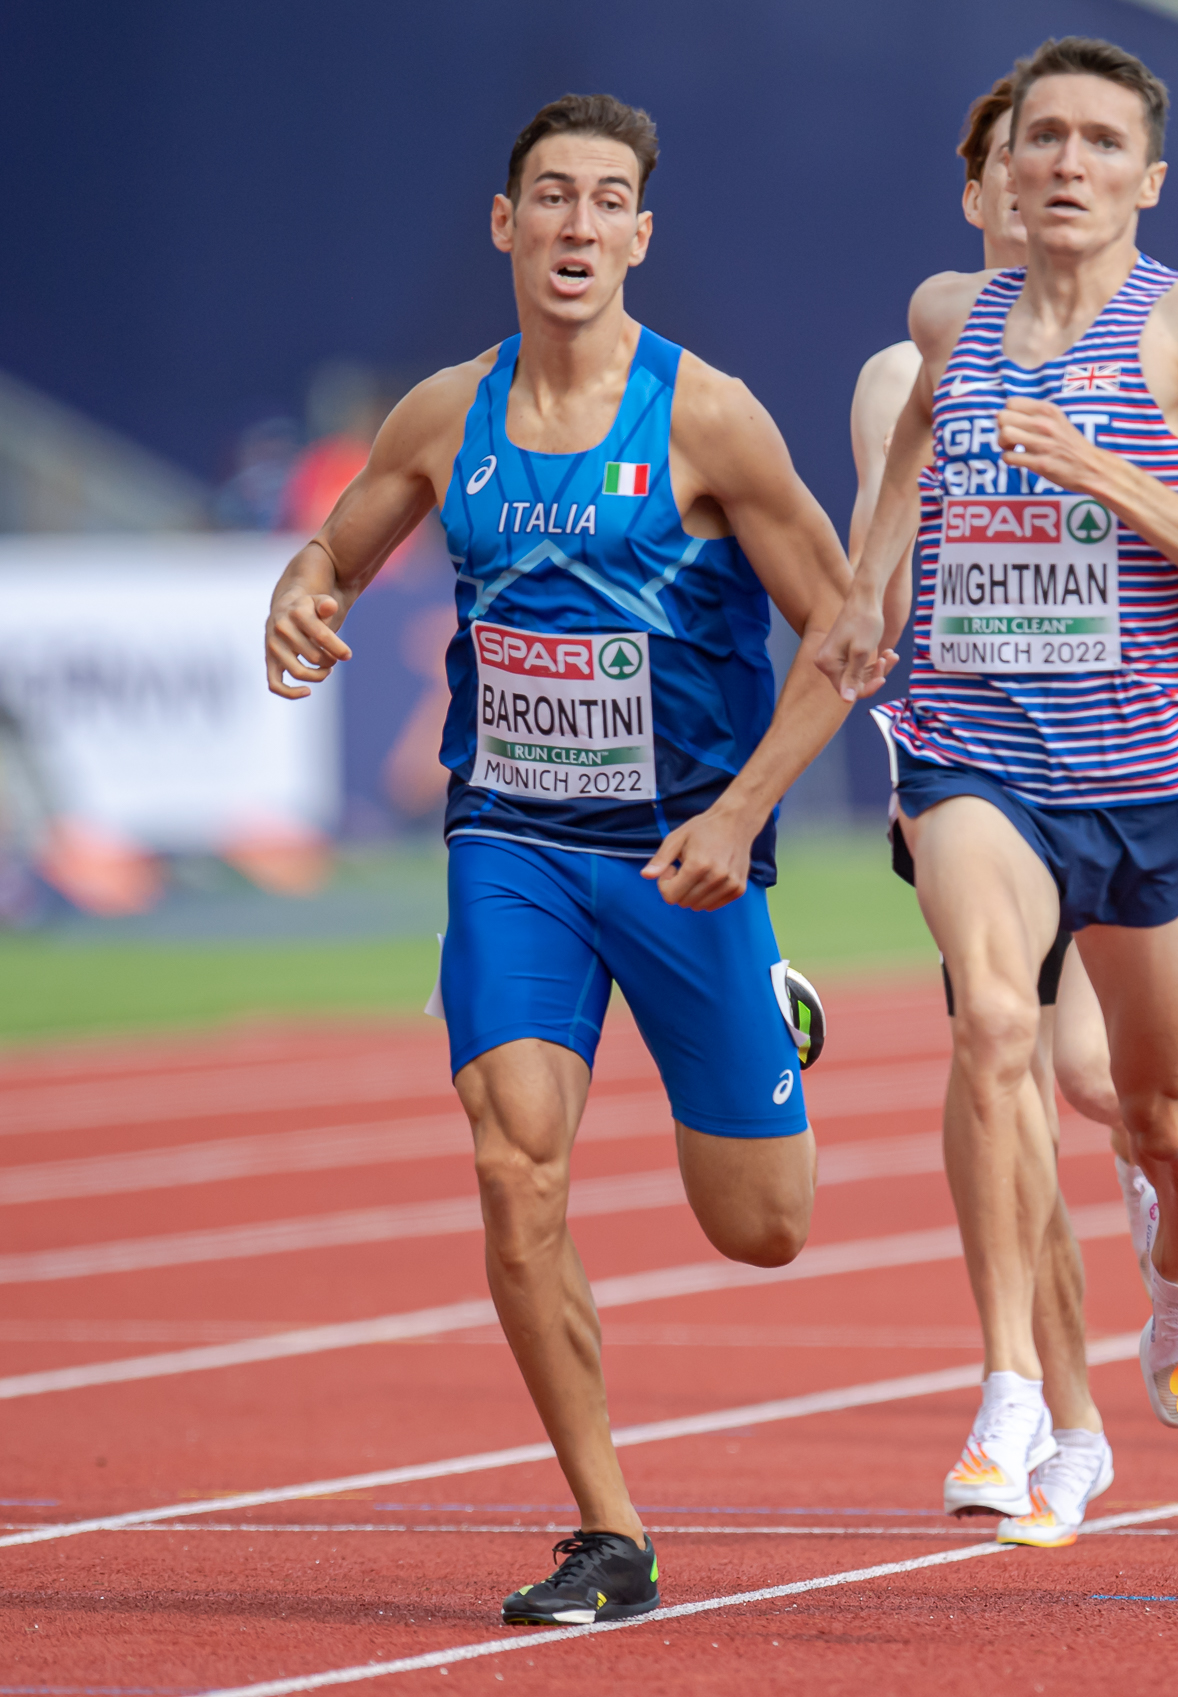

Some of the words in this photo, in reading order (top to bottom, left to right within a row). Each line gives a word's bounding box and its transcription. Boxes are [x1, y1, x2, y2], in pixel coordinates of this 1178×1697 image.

[943, 413, 1110, 456] GRT
[944, 459, 1064, 496] BRITA
[498, 502, 596, 535] ITALIA
[947, 505, 1059, 538] SPAR
[941, 563, 1108, 606] WIGHTMAN
[971, 618, 1008, 634] RUN
[479, 631, 592, 675] SPAR
[940, 641, 1031, 664] MUNICH
[1042, 640, 1106, 664] 2022
[482, 683, 644, 739] BARONTINI
[514, 744, 548, 761] RUN
[484, 760, 568, 793] MUNICH
[578, 770, 642, 794] 2022
